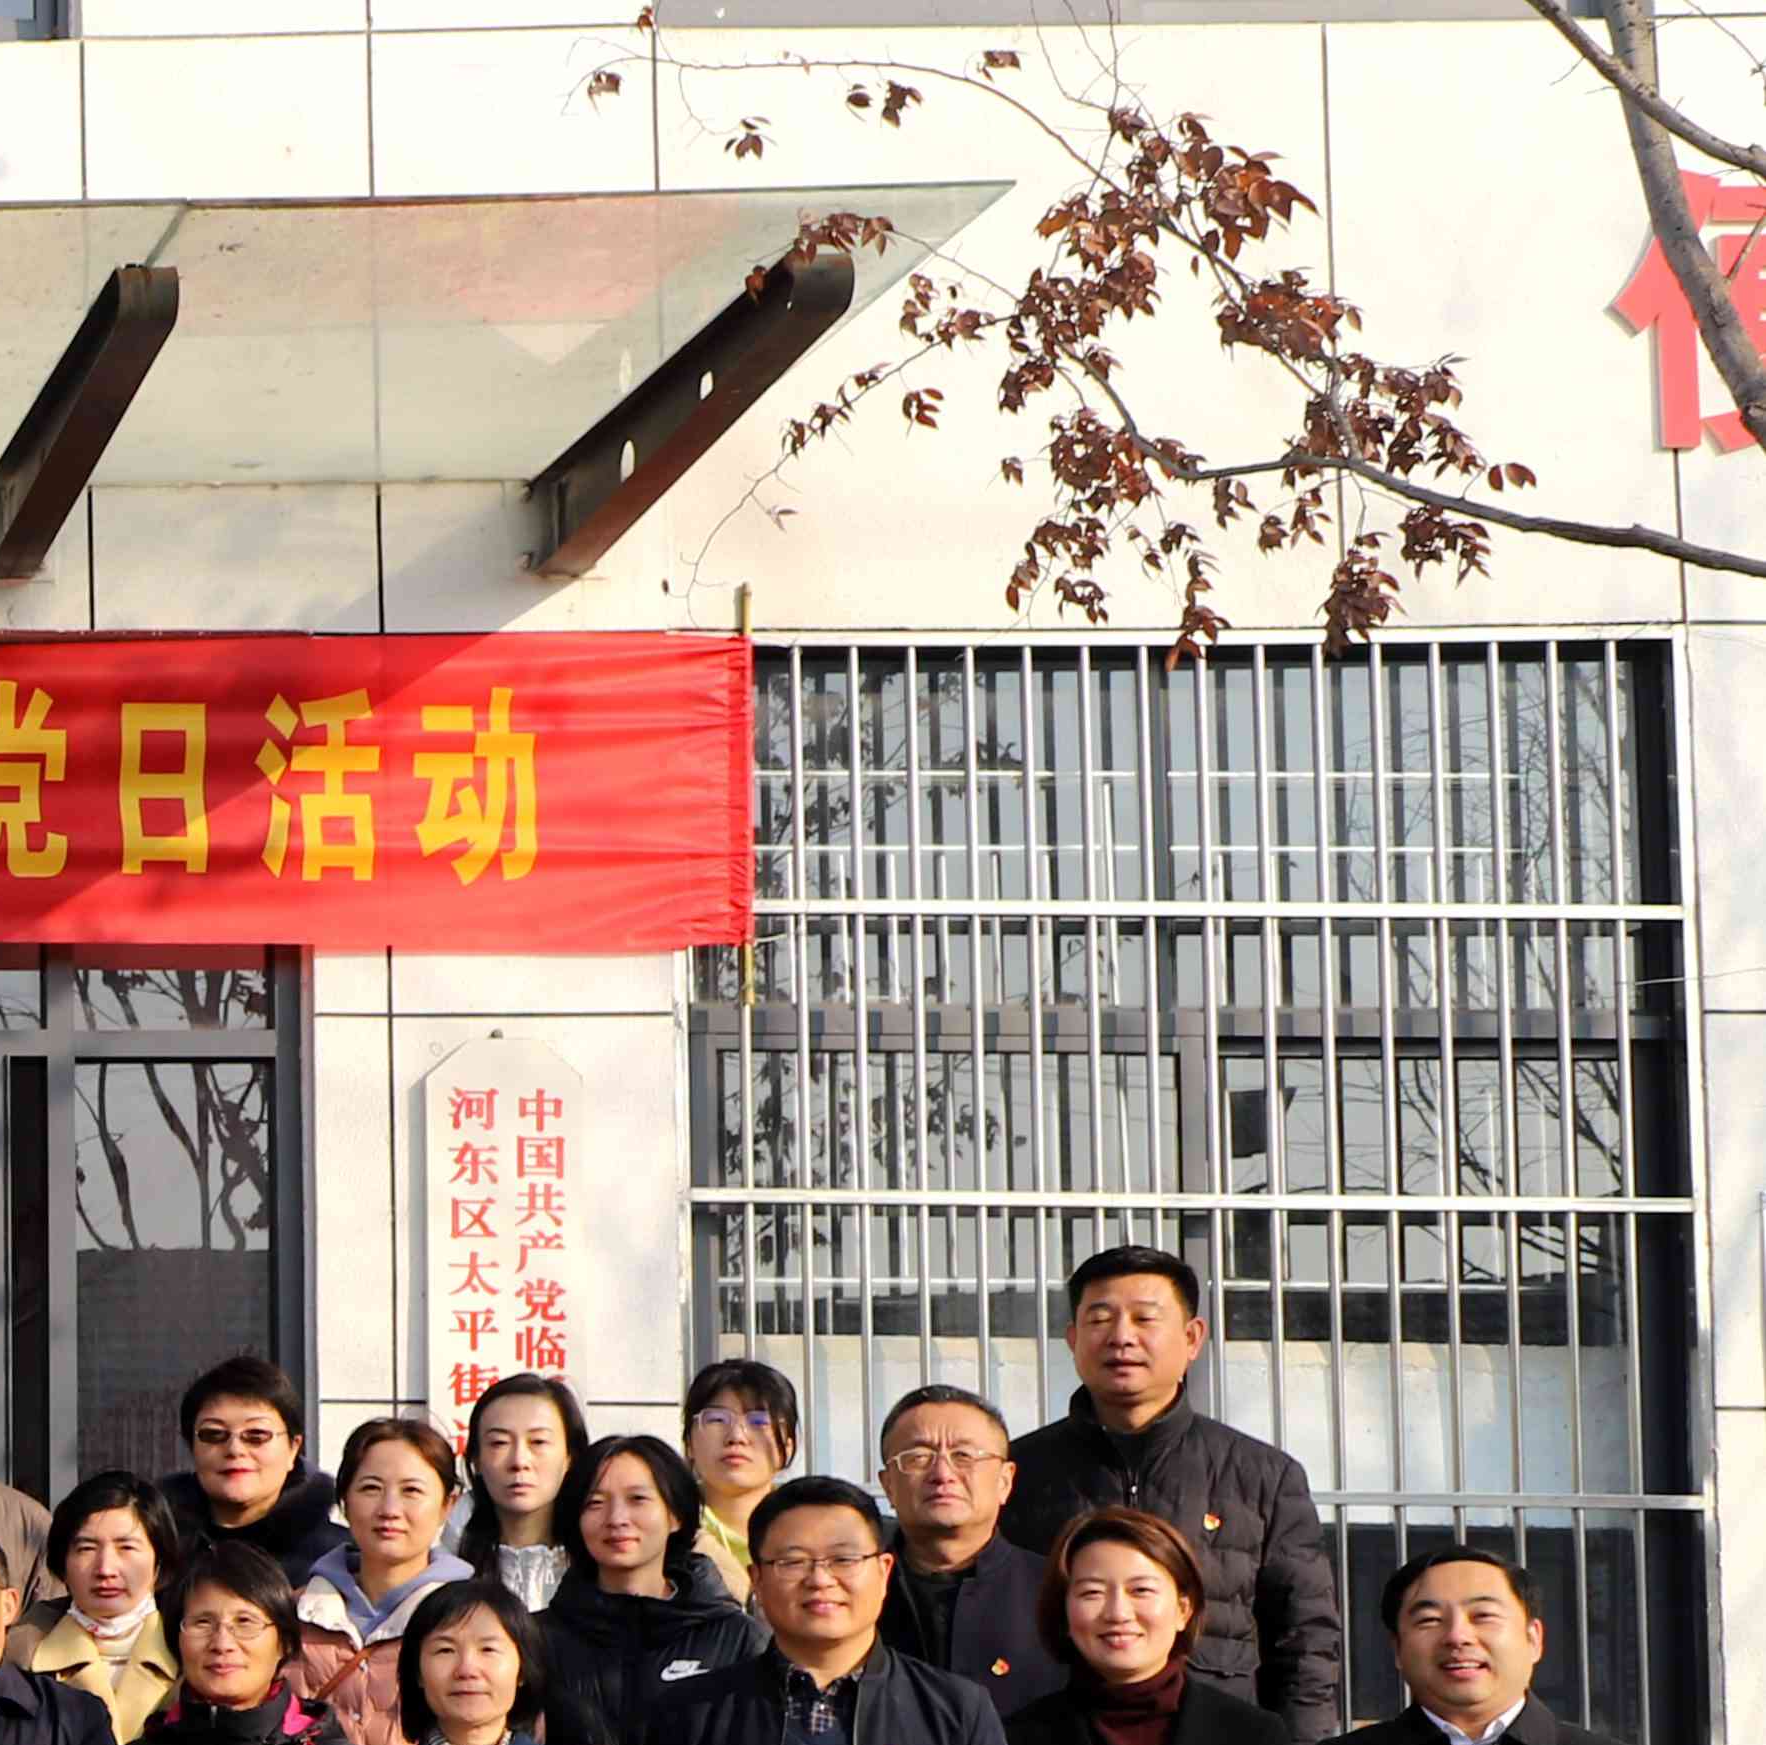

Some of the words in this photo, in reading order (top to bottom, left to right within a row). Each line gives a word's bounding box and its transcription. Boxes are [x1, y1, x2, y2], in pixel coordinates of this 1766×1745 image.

[515, 1088, 567, 1386] 中国共产党临
